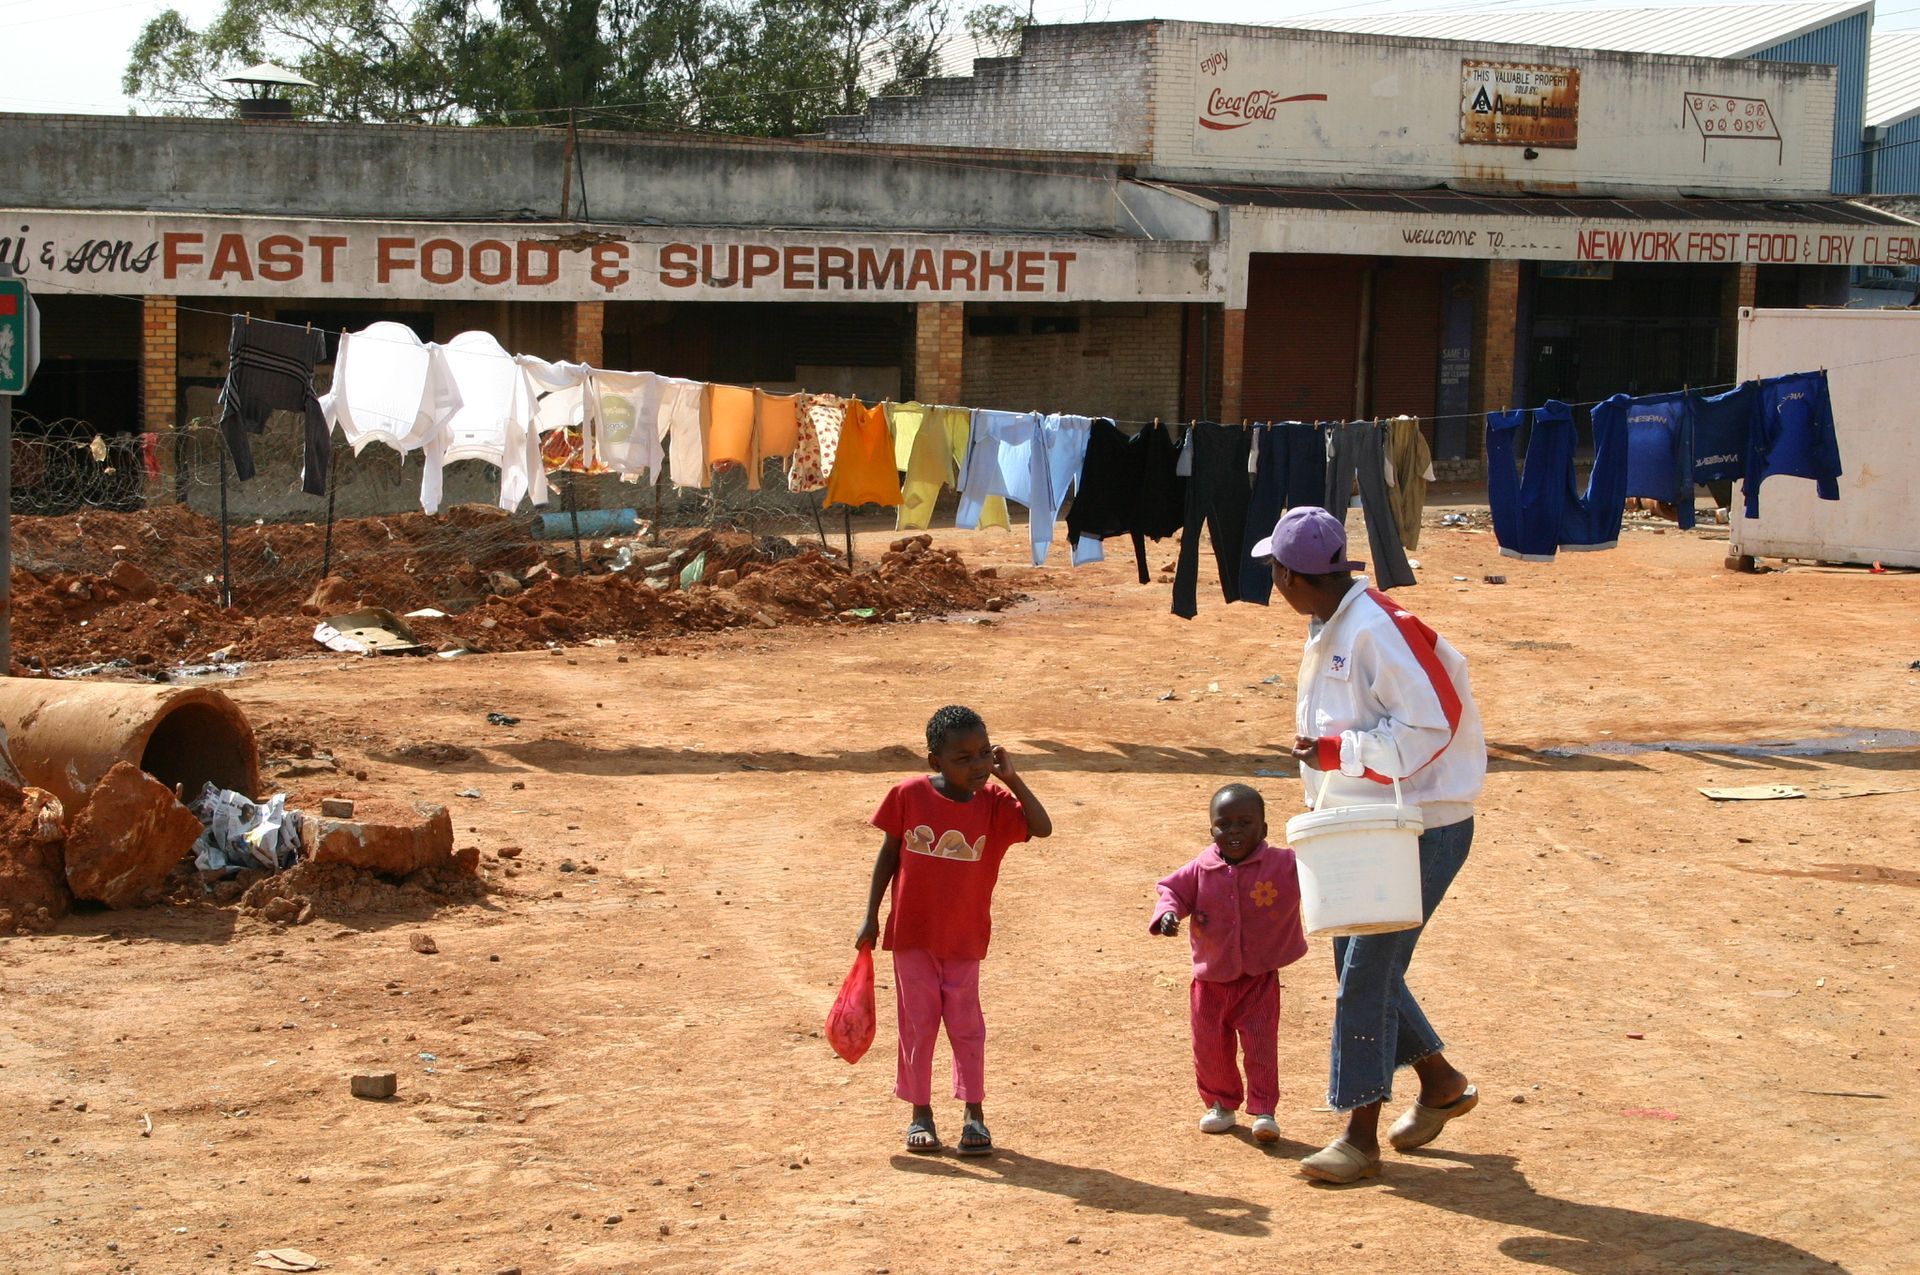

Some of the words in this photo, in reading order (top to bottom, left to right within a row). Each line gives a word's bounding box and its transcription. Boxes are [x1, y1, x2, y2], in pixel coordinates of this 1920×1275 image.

[1200, 48, 1228, 76] Enjoy
[1474, 70, 1490, 82] THIS
[1495, 71, 1530, 84] VALUABLE
[1514, 86, 1528, 95] SOLD
[1493, 94, 1539, 122] Academy
[1540, 96, 1574, 119] Estates
[1402, 229, 1477, 246] WELLCOME
[1686, 232, 1740, 261] FAST
[1745, 233, 1797, 263] FOOD
[1802, 235, 1812, 263] &
[1817, 235, 1855, 264] DRY
[40, 240, 55, 271] &
[60, 239, 160, 275] sons
[163, 232, 348, 283] FAST
[377, 236, 560, 286] FOOD
[590, 242, 630, 294] &
[658, 243, 1077, 293] SUPERMARKET
